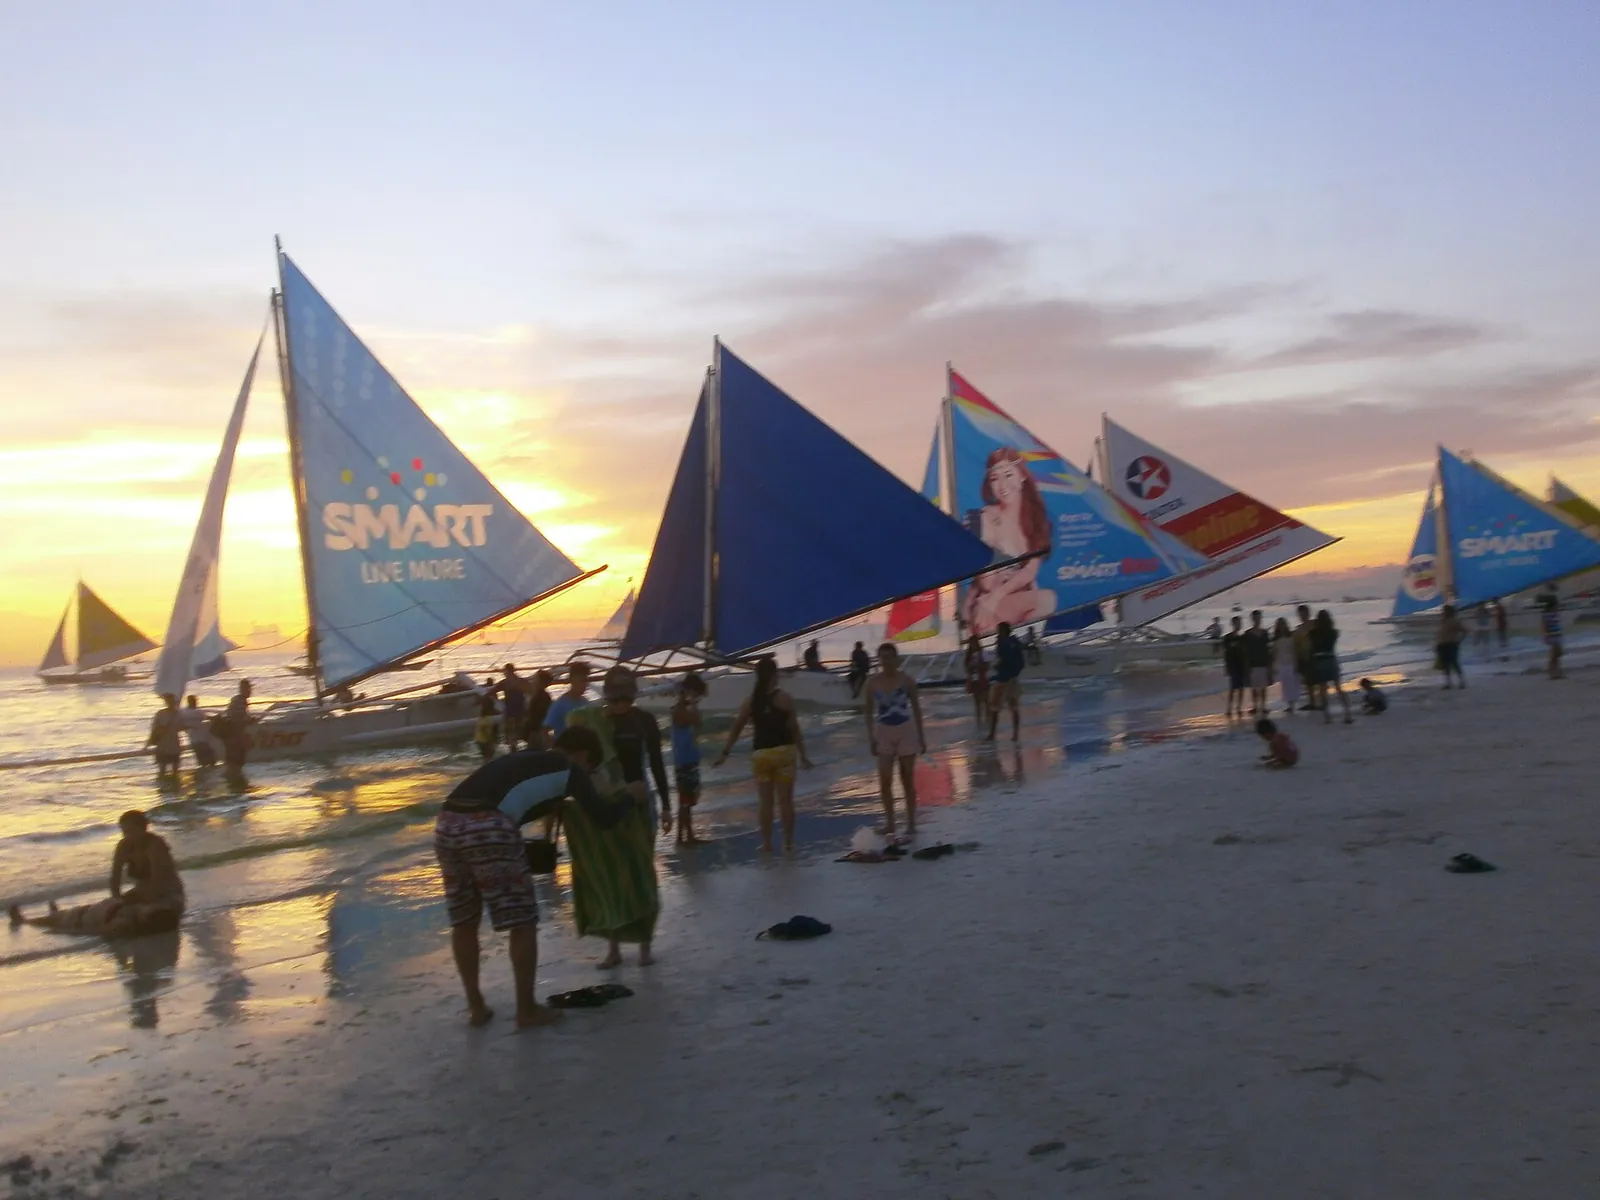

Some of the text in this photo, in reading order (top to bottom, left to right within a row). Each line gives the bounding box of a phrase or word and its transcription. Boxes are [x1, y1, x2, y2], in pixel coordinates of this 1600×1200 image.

[323, 501, 493, 551] SMART
[1457, 529, 1560, 559] SMART
[360, 557, 467, 584] LIVE MORE
[1057, 560, 1122, 580] SMART
